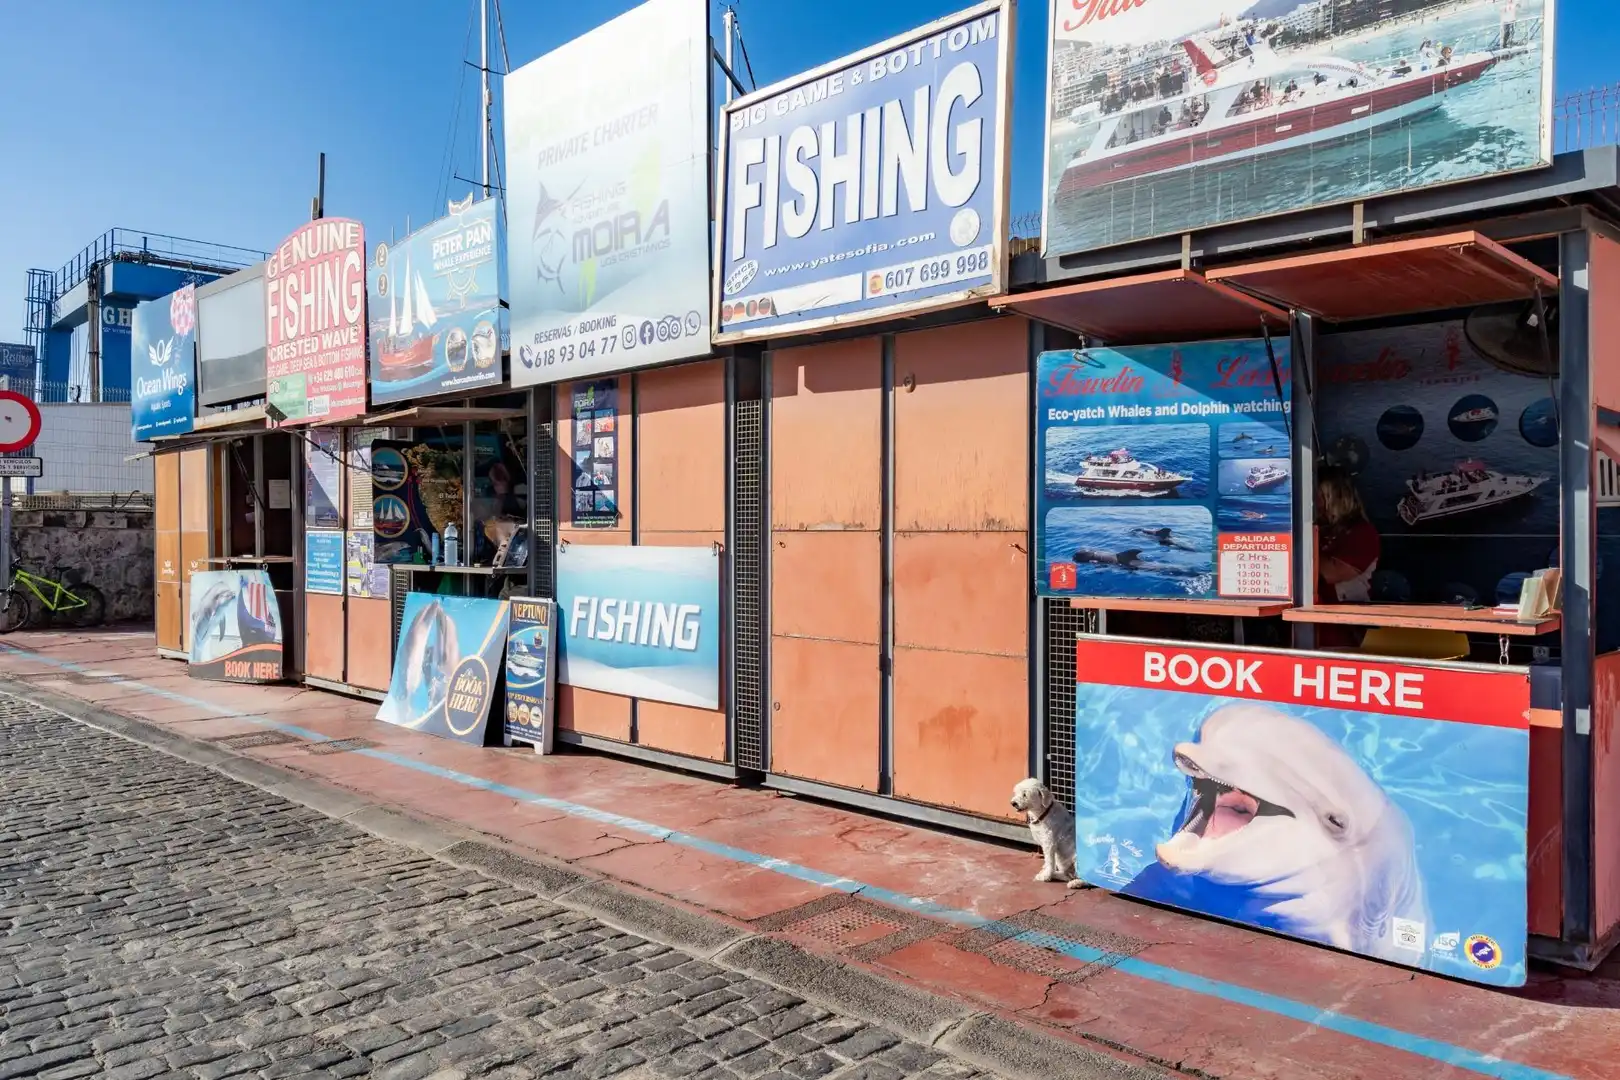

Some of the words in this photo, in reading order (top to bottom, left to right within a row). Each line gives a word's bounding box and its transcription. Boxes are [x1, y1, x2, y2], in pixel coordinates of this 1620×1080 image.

[730, 101, 767, 132] BIG
[772, 73, 844, 116] GAME
[850, 68, 863, 86] &
[869, 13, 998, 82] BOTTOM
[537, 131, 590, 170] PRIVATE
[593, 103, 658, 147] CHARTER
[732, 61, 984, 262] FISHING
[572, 181, 628, 214] FISHING
[267, 222, 359, 278] GENUINE
[432, 233, 462, 260] PETER
[466, 222, 491, 248] PAN
[600, 254, 618, 268] LOS
[619, 238, 672, 264] CRISTIANOS
[764, 231, 936, 276] www.yatesofia.com
[726, 261, 755, 288] SINCE
[885, 267, 914, 290] 607
[920, 259, 950, 283] 699
[957, 251, 988, 276] 998
[268, 250, 362, 344] FISHING
[534, 324, 572, 344] RESERVAS
[579, 315, 617, 335] BOOKING
[534, 348, 555, 368] 618
[560, 344, 574, 363] 93
[579, 340, 596, 359] 04
[600, 336, 617, 354] 77
[136, 376, 161, 399] Ocean
[162, 368, 187, 396] Wings
[1048, 407, 1105, 422] Eco-yatch
[1108, 404, 1152, 418] Whales
[1154, 403, 1178, 416] and
[1182, 401, 1230, 418] Dolphin
[1233, 399, 1291, 414] watching
[512, 602, 548, 625] NEPTUNO
[570, 595, 702, 651] FISHING
[224, 660, 250, 678] BOOK
[253, 662, 279, 679] HERE
[1143, 650, 1263, 695] BOOK
[1293, 663, 1425, 710] HERE
[454, 677, 482, 696] BOOK
[449, 693, 480, 714] HERE
[1438, 936, 1457, 947] ISO
